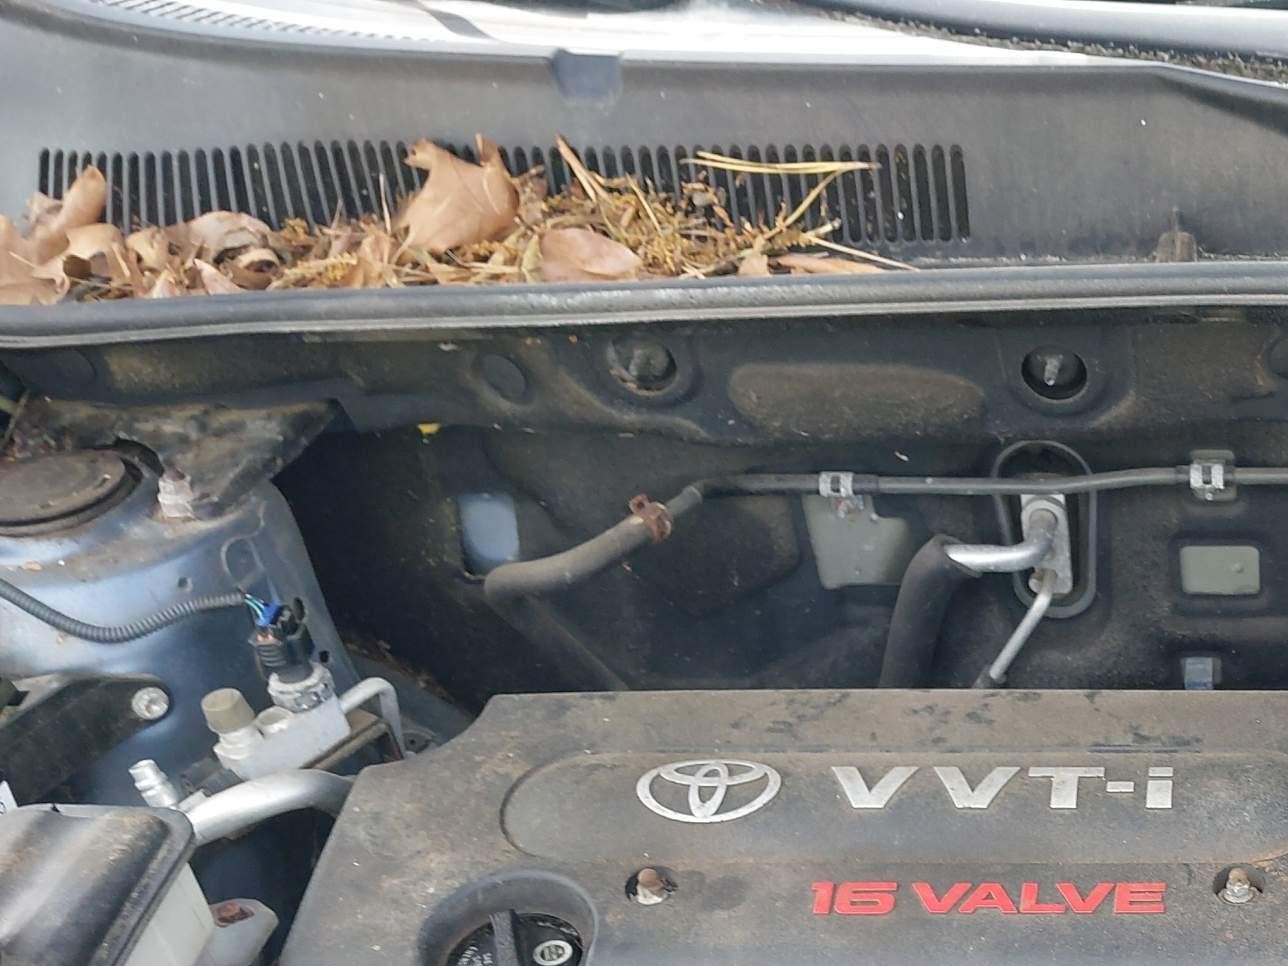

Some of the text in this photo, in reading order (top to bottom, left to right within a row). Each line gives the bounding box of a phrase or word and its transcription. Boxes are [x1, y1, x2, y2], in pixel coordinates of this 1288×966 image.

[832, 766, 1174, 809] VVT-i
[811, 882, 1168, 914] 16 VALVE
